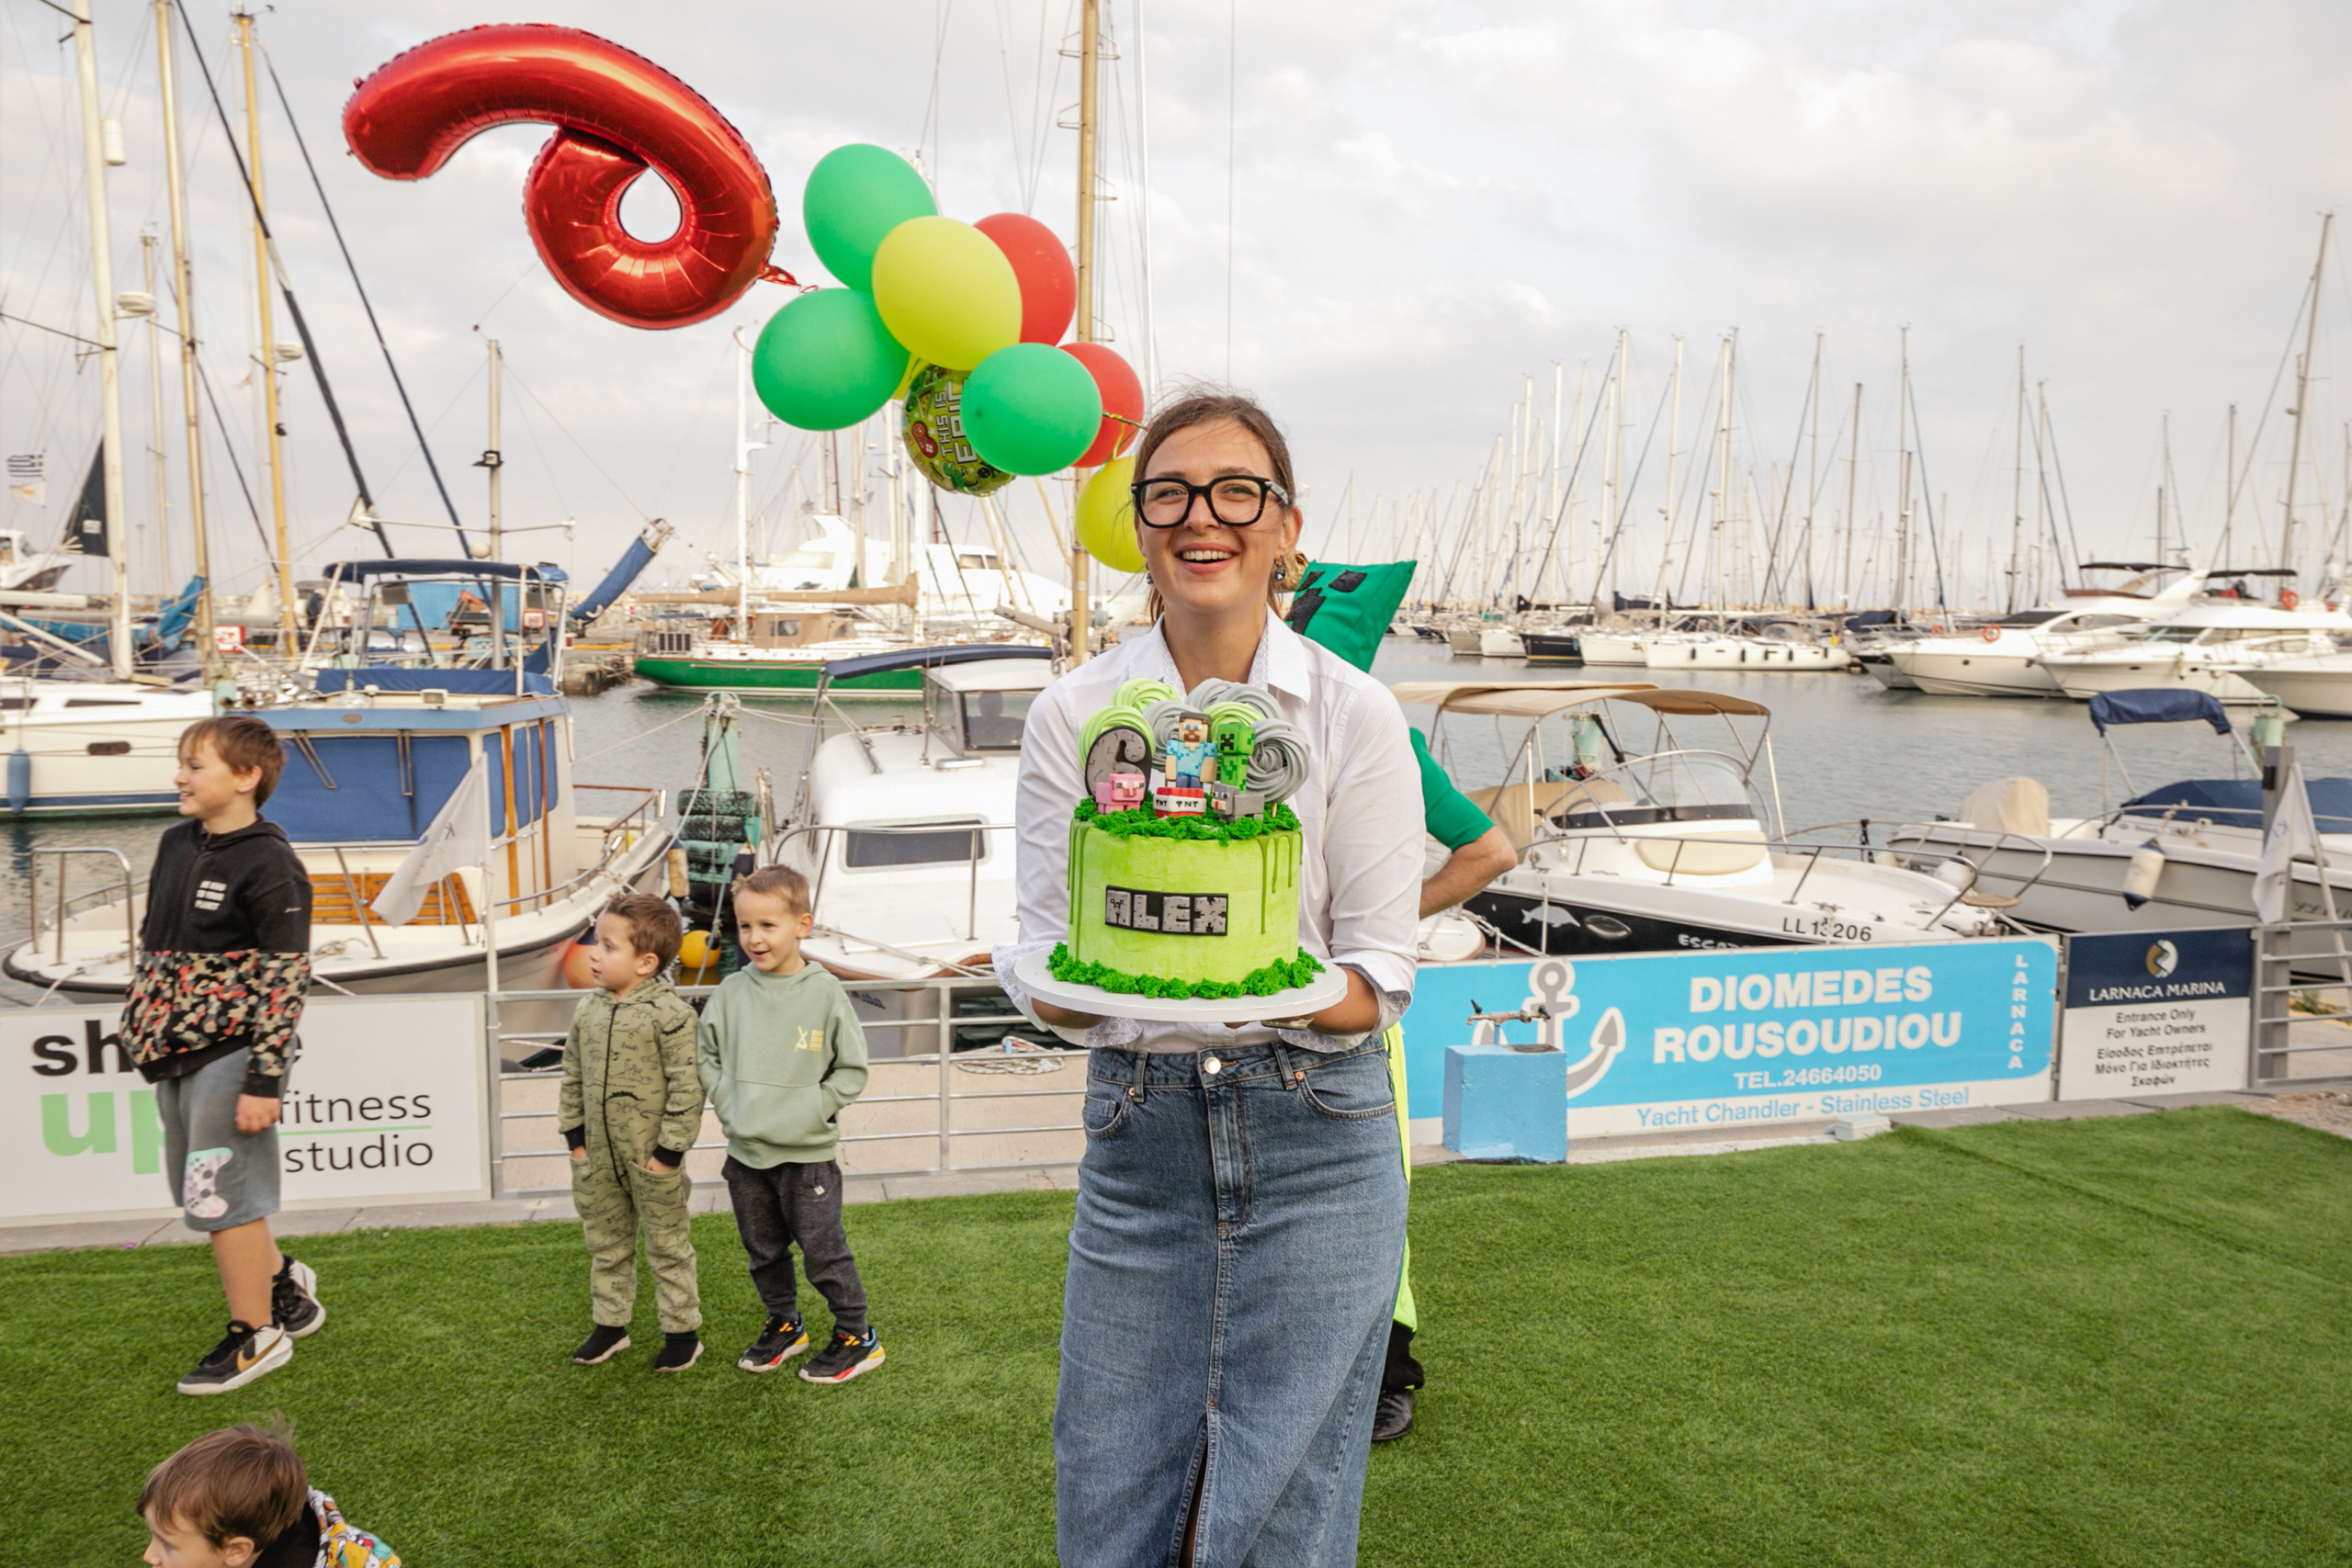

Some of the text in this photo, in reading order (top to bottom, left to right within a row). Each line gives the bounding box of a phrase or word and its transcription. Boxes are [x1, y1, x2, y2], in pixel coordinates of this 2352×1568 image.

[934, 391, 953, 458] THIS IS
[1156, 799, 1168, 807] TNT
[1176, 800, 1199, 808] TNT
[1105, 889, 1227, 933] ALEX
[1782, 917, 1805, 934] LL
[1690, 965, 1933, 1013] DIOMEDES
[2089, 981, 2227, 1002] LARNACA MARINA
[2007, 953, 2029, 1069] LARNACA
[2116, 1009, 2196, 1024] Entrance Only
[1653, 1011, 1962, 1064] ROUSOUDIOU
[2107, 1023, 2207, 1040] For Yacht Owners
[2097, 1043, 2213, 1060] Είσοδος Επιτρέπεται
[1734, 1064, 1883, 1089] TEL.24664050
[2095, 1057, 2211, 1075] Μόνο Για Ιδιοκτήτες
[2131, 1074, 2177, 1089] Σκαφών
[1636, 1105, 1699, 1127] Yacht
[1705, 1100, 1801, 1122] Chandler
[1820, 1092, 1913, 1114] Stainless
[1918, 1087, 1970, 1109] Steel
[285, 1134, 434, 1173] studio
